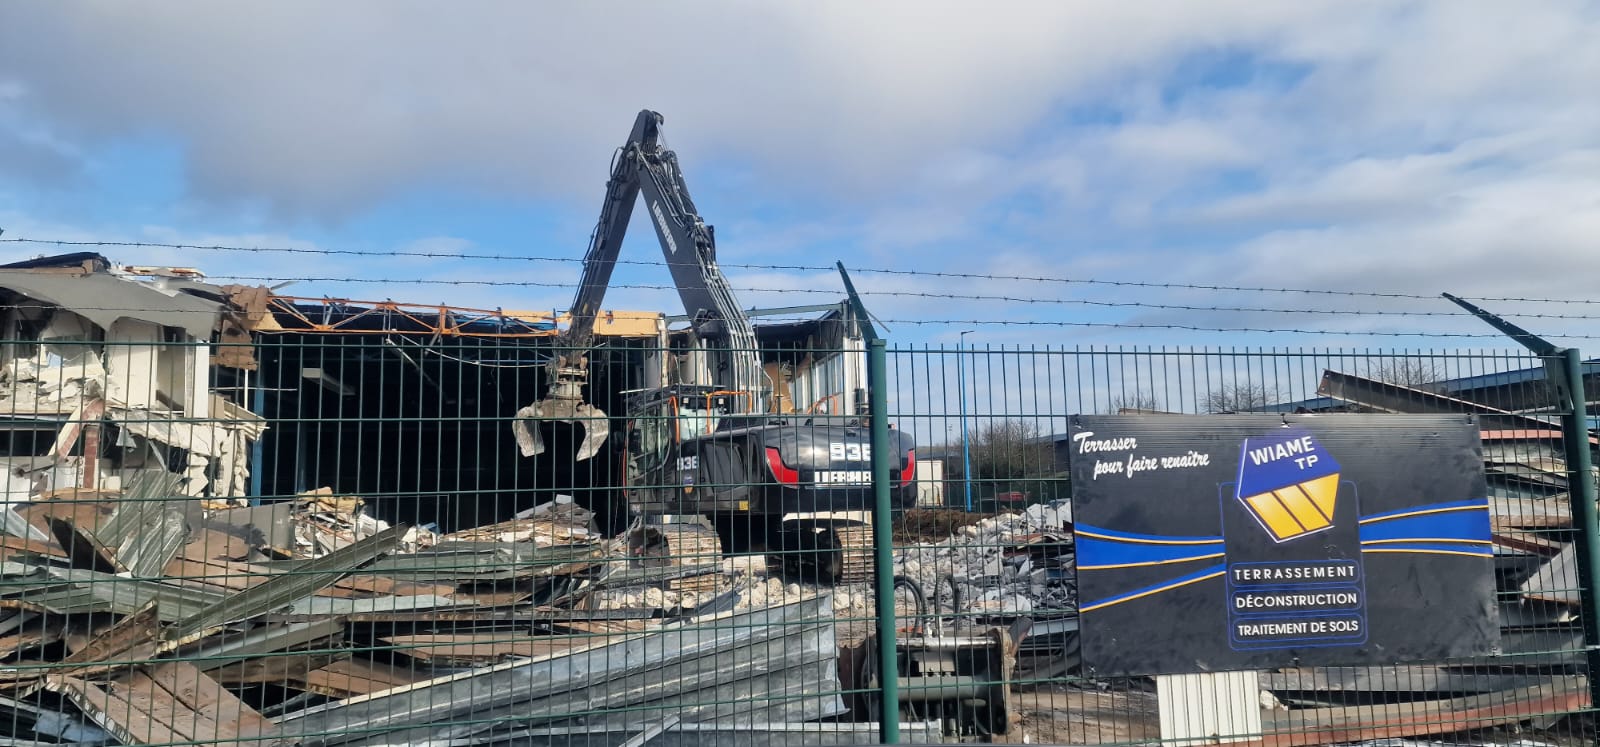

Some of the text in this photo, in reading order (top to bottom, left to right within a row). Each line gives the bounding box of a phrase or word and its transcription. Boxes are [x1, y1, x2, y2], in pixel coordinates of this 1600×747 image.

[1073, 431, 1138, 454] Terrasser
[1249, 436, 1315, 466] WIAME
[1093, 450, 1210, 480] pour faire renaître
[1294, 454, 1319, 470] TP
[1234, 565, 1355, 580] TERRASSEMENT
[1235, 593, 1357, 608] DÉCONSTRUCTION
[1238, 620, 1359, 636] TRAITEMENT DE SOLS
